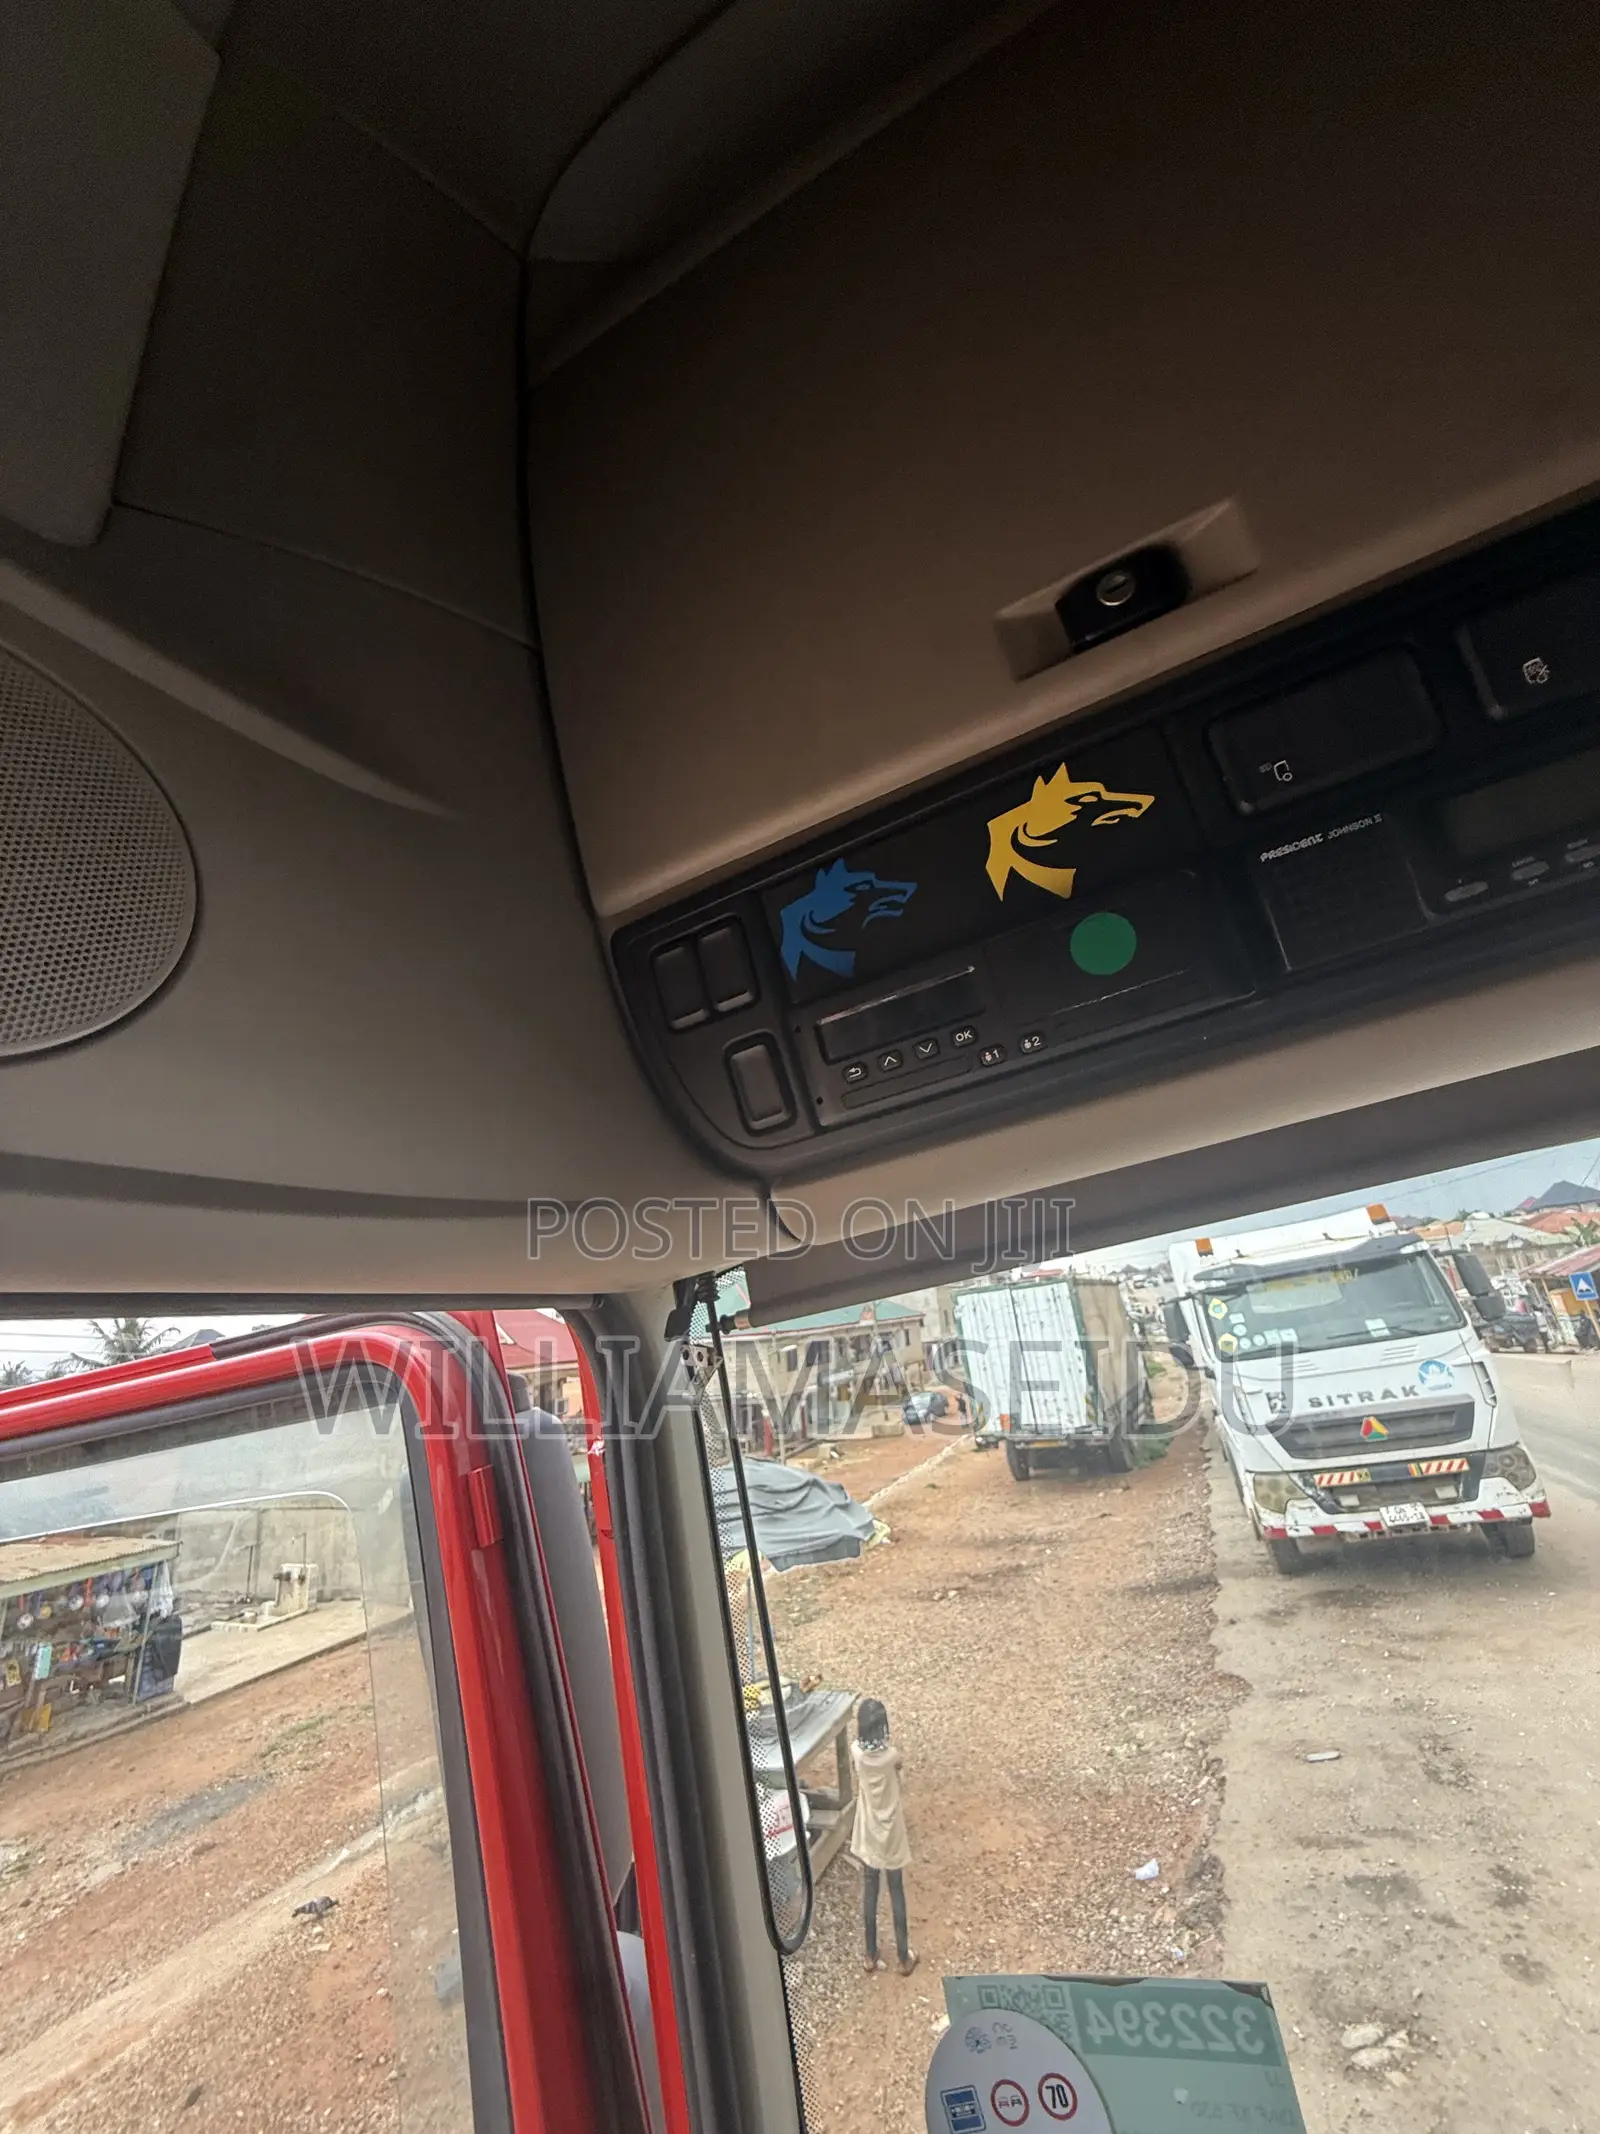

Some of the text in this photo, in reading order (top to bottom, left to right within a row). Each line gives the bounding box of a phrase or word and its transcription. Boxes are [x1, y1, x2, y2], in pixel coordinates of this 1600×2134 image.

[1260, 833, 1324, 862] PRESIDENT
[1327, 818, 1373, 840] JOHNSON
[955, 1030, 972, 1042] OK
[1032, 1036, 1041, 1046] 2
[993, 1049, 1000, 1058] 1
[1308, 1385, 1419, 1408] SITRAK
[1045, 2084, 1069, 2109] 70
